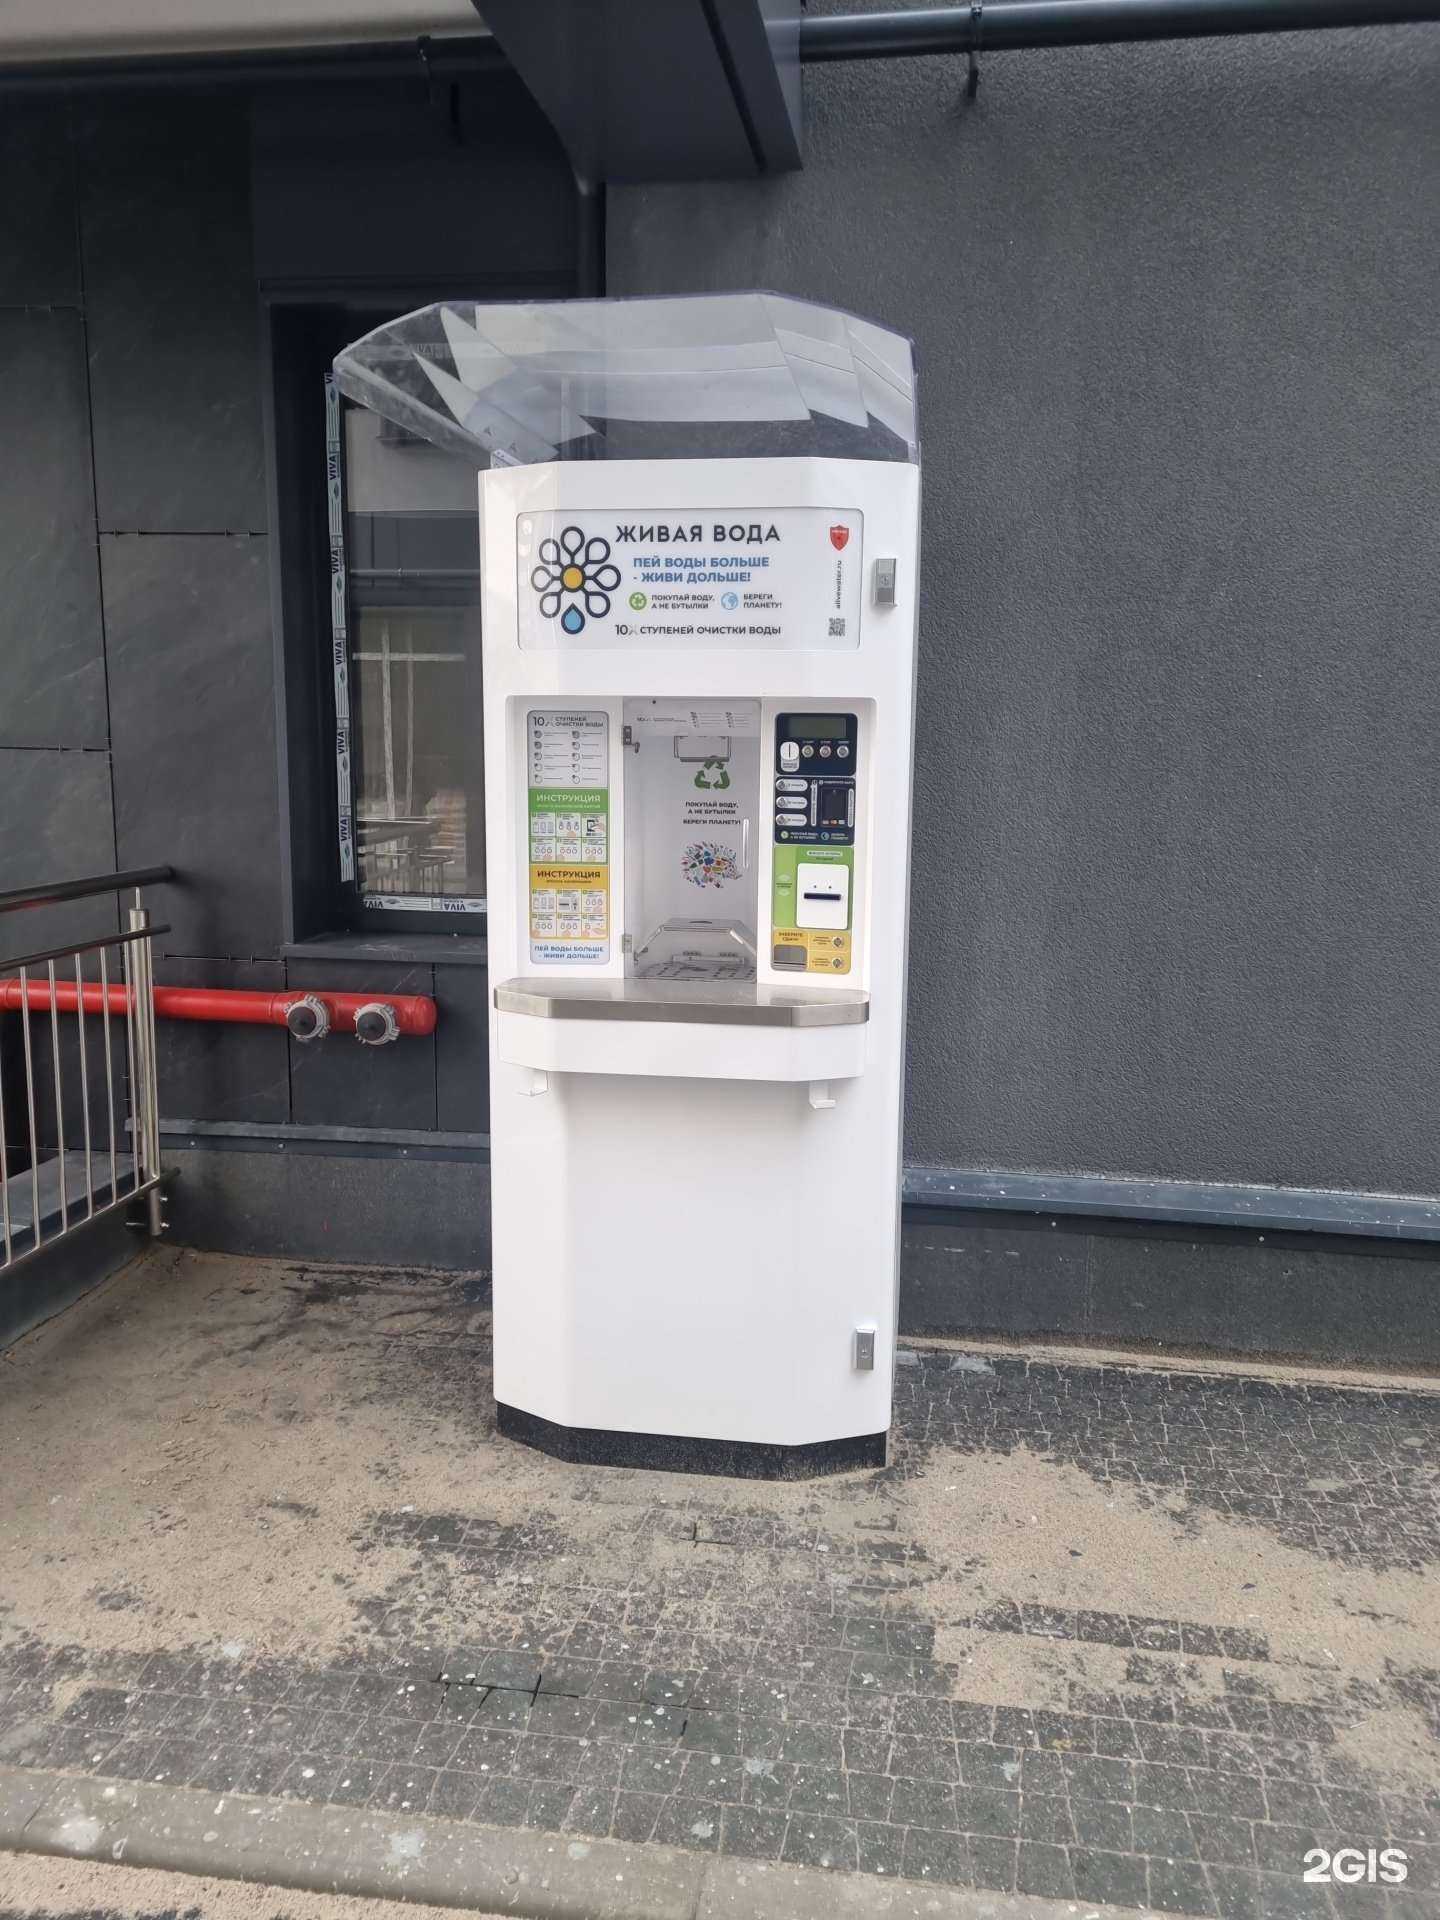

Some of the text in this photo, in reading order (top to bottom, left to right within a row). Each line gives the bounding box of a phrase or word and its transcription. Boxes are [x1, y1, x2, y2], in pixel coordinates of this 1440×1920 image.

[329, 454, 337, 480] VIVA
[616, 524, 781, 544] ЖИВАЯ ВОДА
[331, 549, 339, 574] VIVA
[633, 555, 769, 569] ПЕЙ ВОДЫ БОЛЬШЕ
[641, 572, 683, 583] ЖИВИ
[686, 571, 751, 584] ДОЛЬШЕ!
[640, 625, 694, 634] СТУПЕНЕЙ
[697, 626, 746, 634] ОЧИСТКИ
[749, 626, 781, 635] ВОДЫ
[335, 641, 343, 665] VIVA
[337, 731, 345, 754] VIVA
[536, 794, 601, 804] ИНСТРУКЦИЯ
[340, 818, 348, 841] VIVA
[537, 870, 601, 879] ИНСТРУКЦИЯ
[444, 903, 466, 911] VIVA
